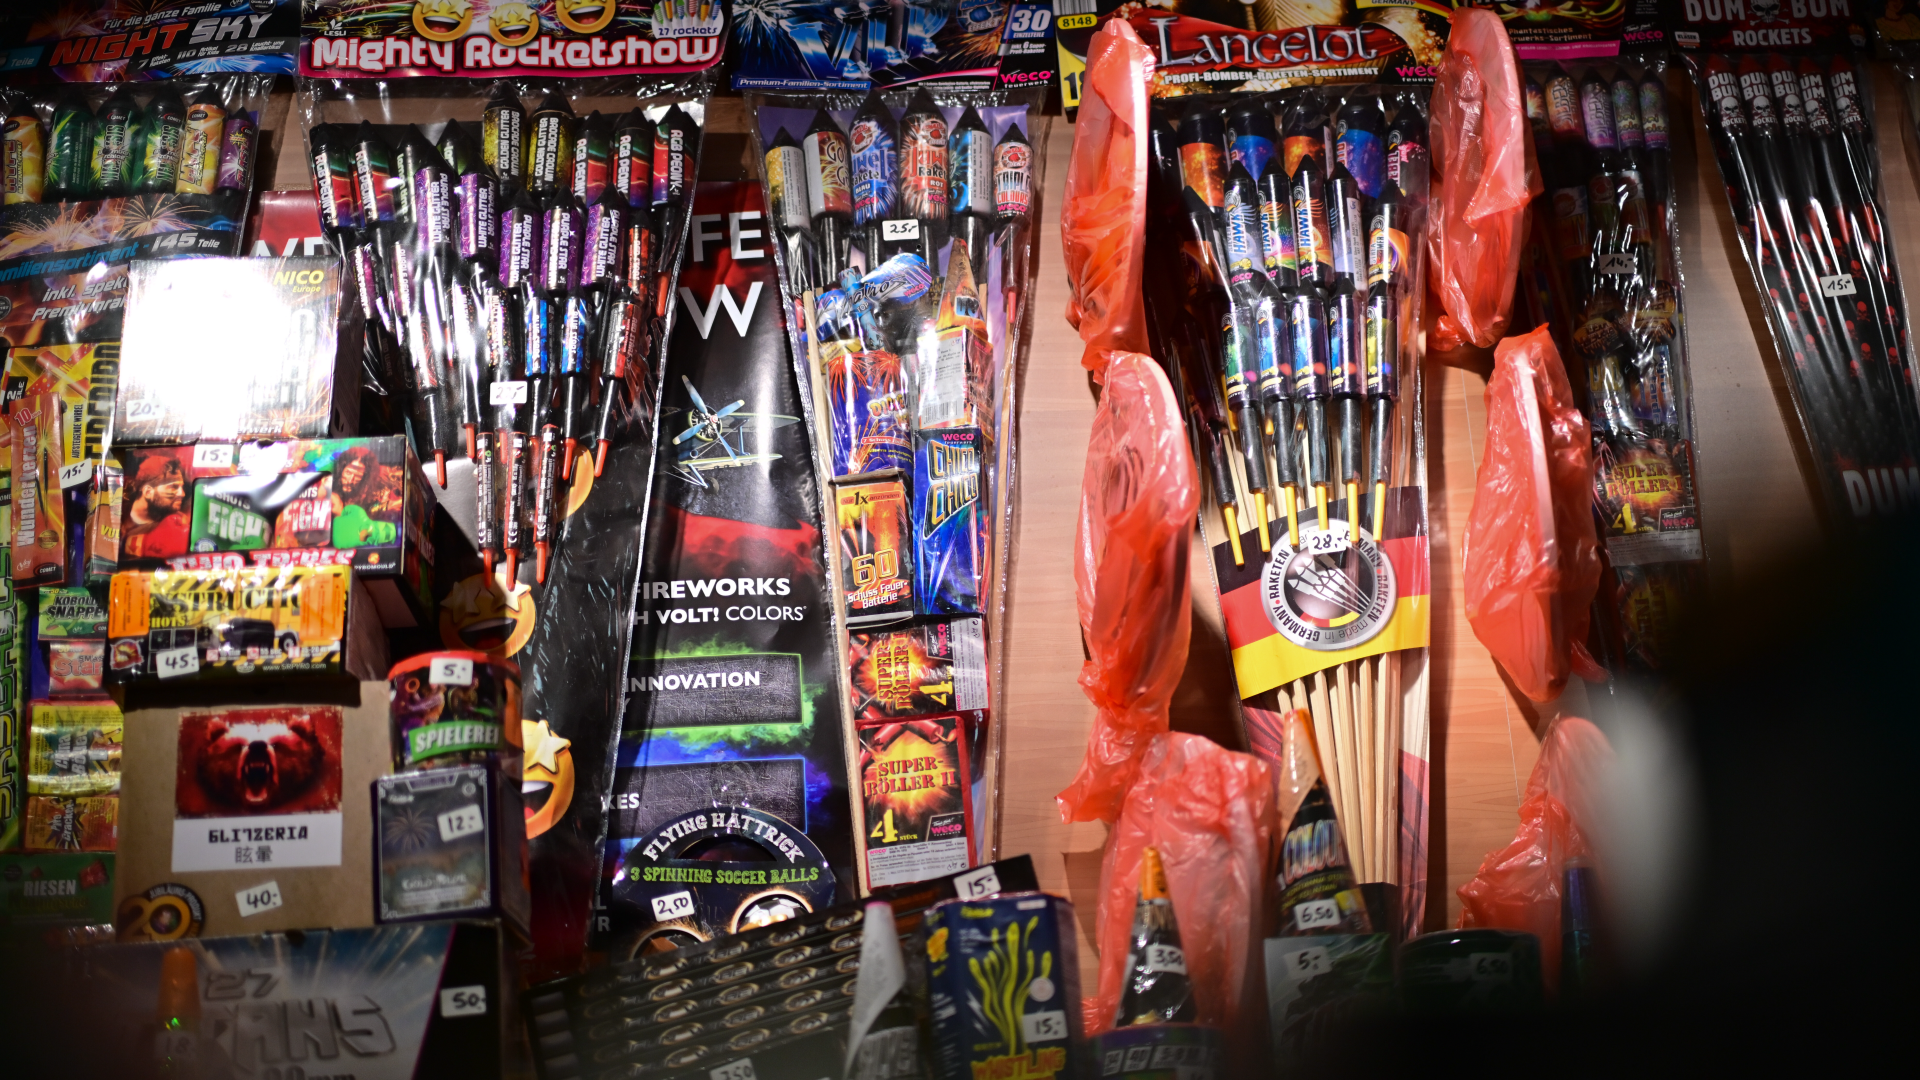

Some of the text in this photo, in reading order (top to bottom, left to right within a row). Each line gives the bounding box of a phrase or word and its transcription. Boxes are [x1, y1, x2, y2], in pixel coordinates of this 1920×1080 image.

[104, 3, 221, 29] Für die ganze Familie
[658, 26, 717, 36] 27 rockets
[1012, 10, 1051, 31] 30
[1062, 16, 1093, 27] 8148
[49, 13, 272, 67] NIGHT SKY
[1150, 16, 1379, 67] Lancelot
[1732, 28, 1813, 46] ROCKETS
[11, 58, 35, 67] Teile
[313, 36, 719, 71] Mighty Rocketshow
[740, 79, 867, 89] Premium-Familien-Sortiment
[1001, 70, 1052, 83] weco
[501, 109, 510, 140] GLITTER
[537, 118, 549, 147] GLITTER
[510, 111, 520, 177] BROCADE CROWN
[544, 117, 559, 182] BROCADE CROWN
[671, 129, 684, 188] RGB PEONY
[574, 138, 586, 197] RGB PEONY
[617, 135, 631, 194] RGB PEONY
[930, 179, 944, 187] ROT
[439, 173, 450, 230] PURPLE STAR
[478, 188, 488, 248] WHITE GLITTER
[1231, 213, 1246, 253] HAWK
[1299, 209, 1312, 248] HAWK
[153, 233, 220, 251] 145 Teile
[511, 223, 522, 282] WHITE GLITTER
[520, 214, 532, 270] PURPLE STAR
[558, 212, 570, 270] PURPLE STAR
[596, 217, 611, 278] WHITE GLITTER
[606, 241, 617, 266] STAR
[273, 270, 324, 286] NICO
[292, 285, 321, 294] Europe
[42, 284, 76, 303] inkl.
[15, 408, 32, 426] 10
[942, 432, 975, 440] weco
[931, 443, 975, 478] CHICO
[17, 425, 38, 547] Wunderkerzen
[854, 491, 869, 506] 1x
[931, 473, 978, 524] CHICO
[1612, 503, 1637, 534] 4
[852, 548, 899, 588] 60
[1269, 548, 1290, 600] RAKETEN
[847, 580, 908, 603] Schuss Feuer-
[862, 591, 898, 609] Batterie
[1370, 574, 1388, 622] RAKETEN
[656, 608, 720, 625] VOLT!
[1272, 604, 1321, 642] GERMANY
[1324, 620, 1369, 640] made in
[937, 623, 948, 657] weco
[919, 681, 953, 706] 4
[416, 725, 499, 753] SPIELEREI
[878, 757, 944, 778] SUPER-
[865, 772, 936, 798] BÖLLER
[643, 812, 806, 864] FLYING HATTRICK
[870, 808, 898, 843] 4
[932, 822, 963, 834] weco
[24, 878, 77, 897] RIESEN
[631, 866, 819, 885] 3 SPINNING SOCCER BALLS
[204, 968, 276, 1000] 27
